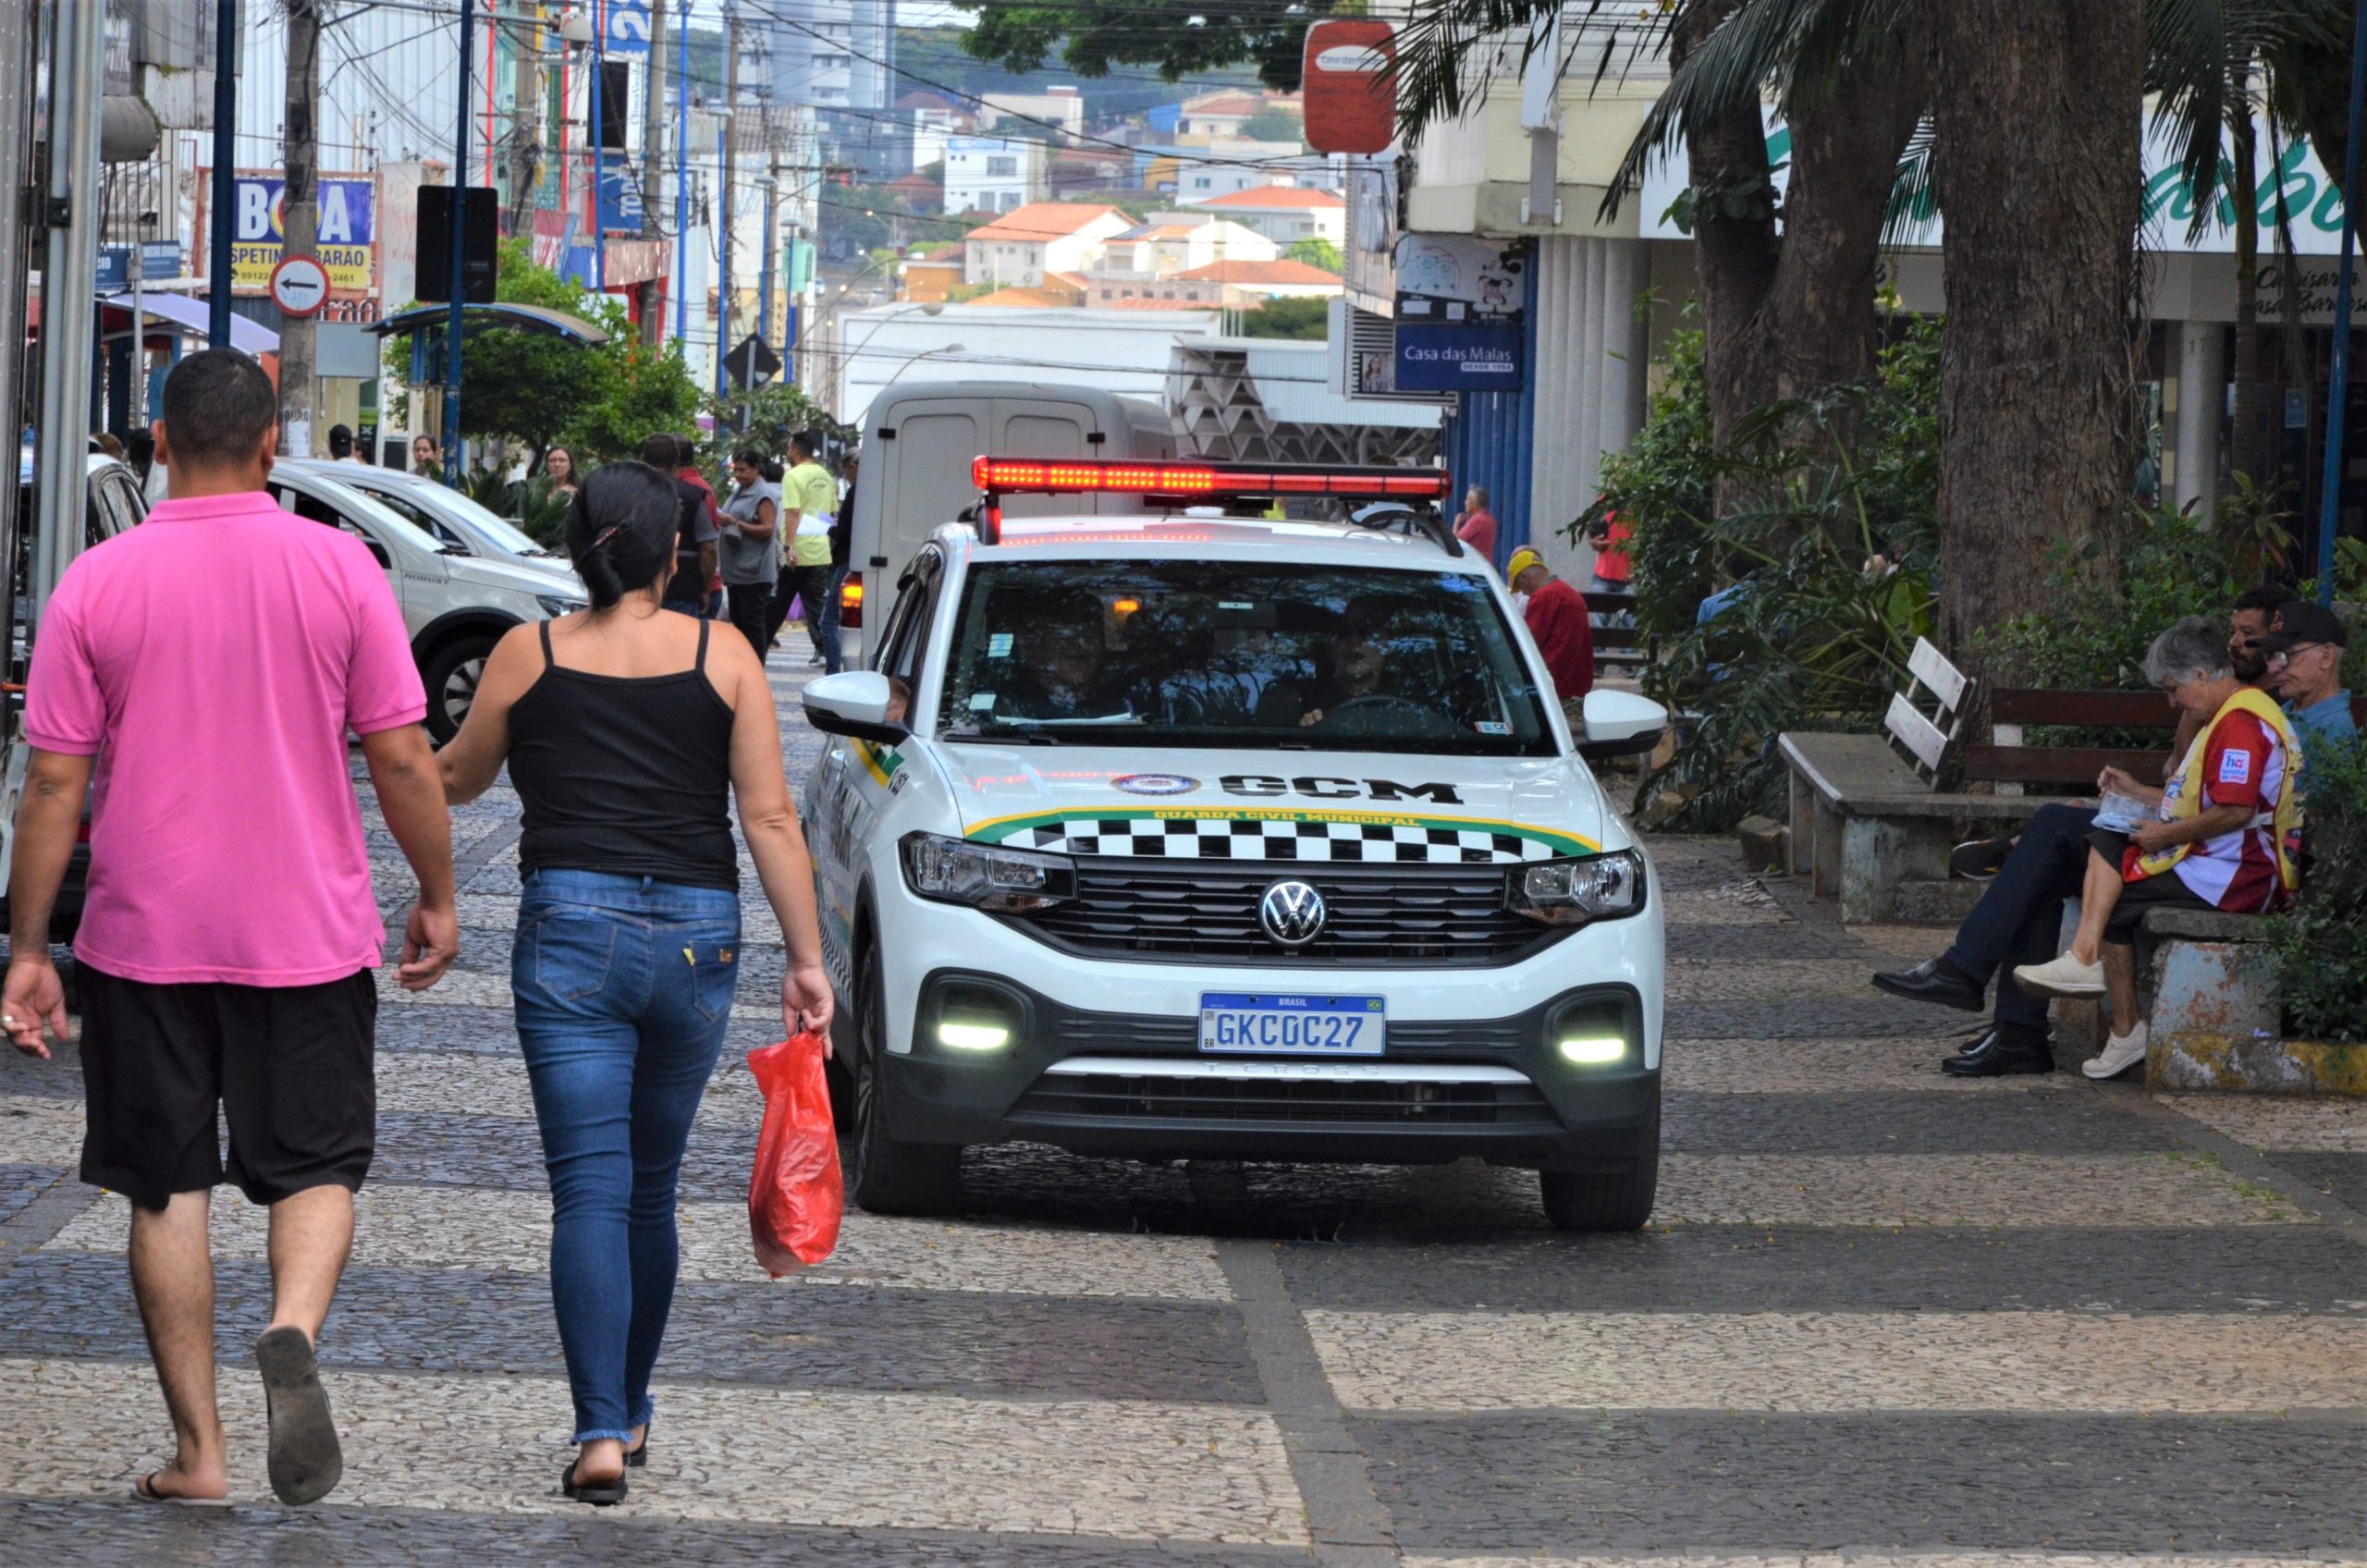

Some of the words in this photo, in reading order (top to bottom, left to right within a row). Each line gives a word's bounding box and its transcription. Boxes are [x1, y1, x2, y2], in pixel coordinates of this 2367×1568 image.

[240, 271, 269, 281] 99122
[1404, 346, 1439, 361] Casa
[1441, 347, 1466, 361] das
[1469, 347, 1512, 361] Malas
[1219, 775, 1465, 805] GCM
[1154, 810, 1233, 820] GUARDA
[1241, 811, 1300, 822] CIVIL
[1306, 814, 1421, 827] MUNICIPAL
[1279, 998, 1307, 1007] BRASIL
[1204, 1038, 1215, 1048] BR
